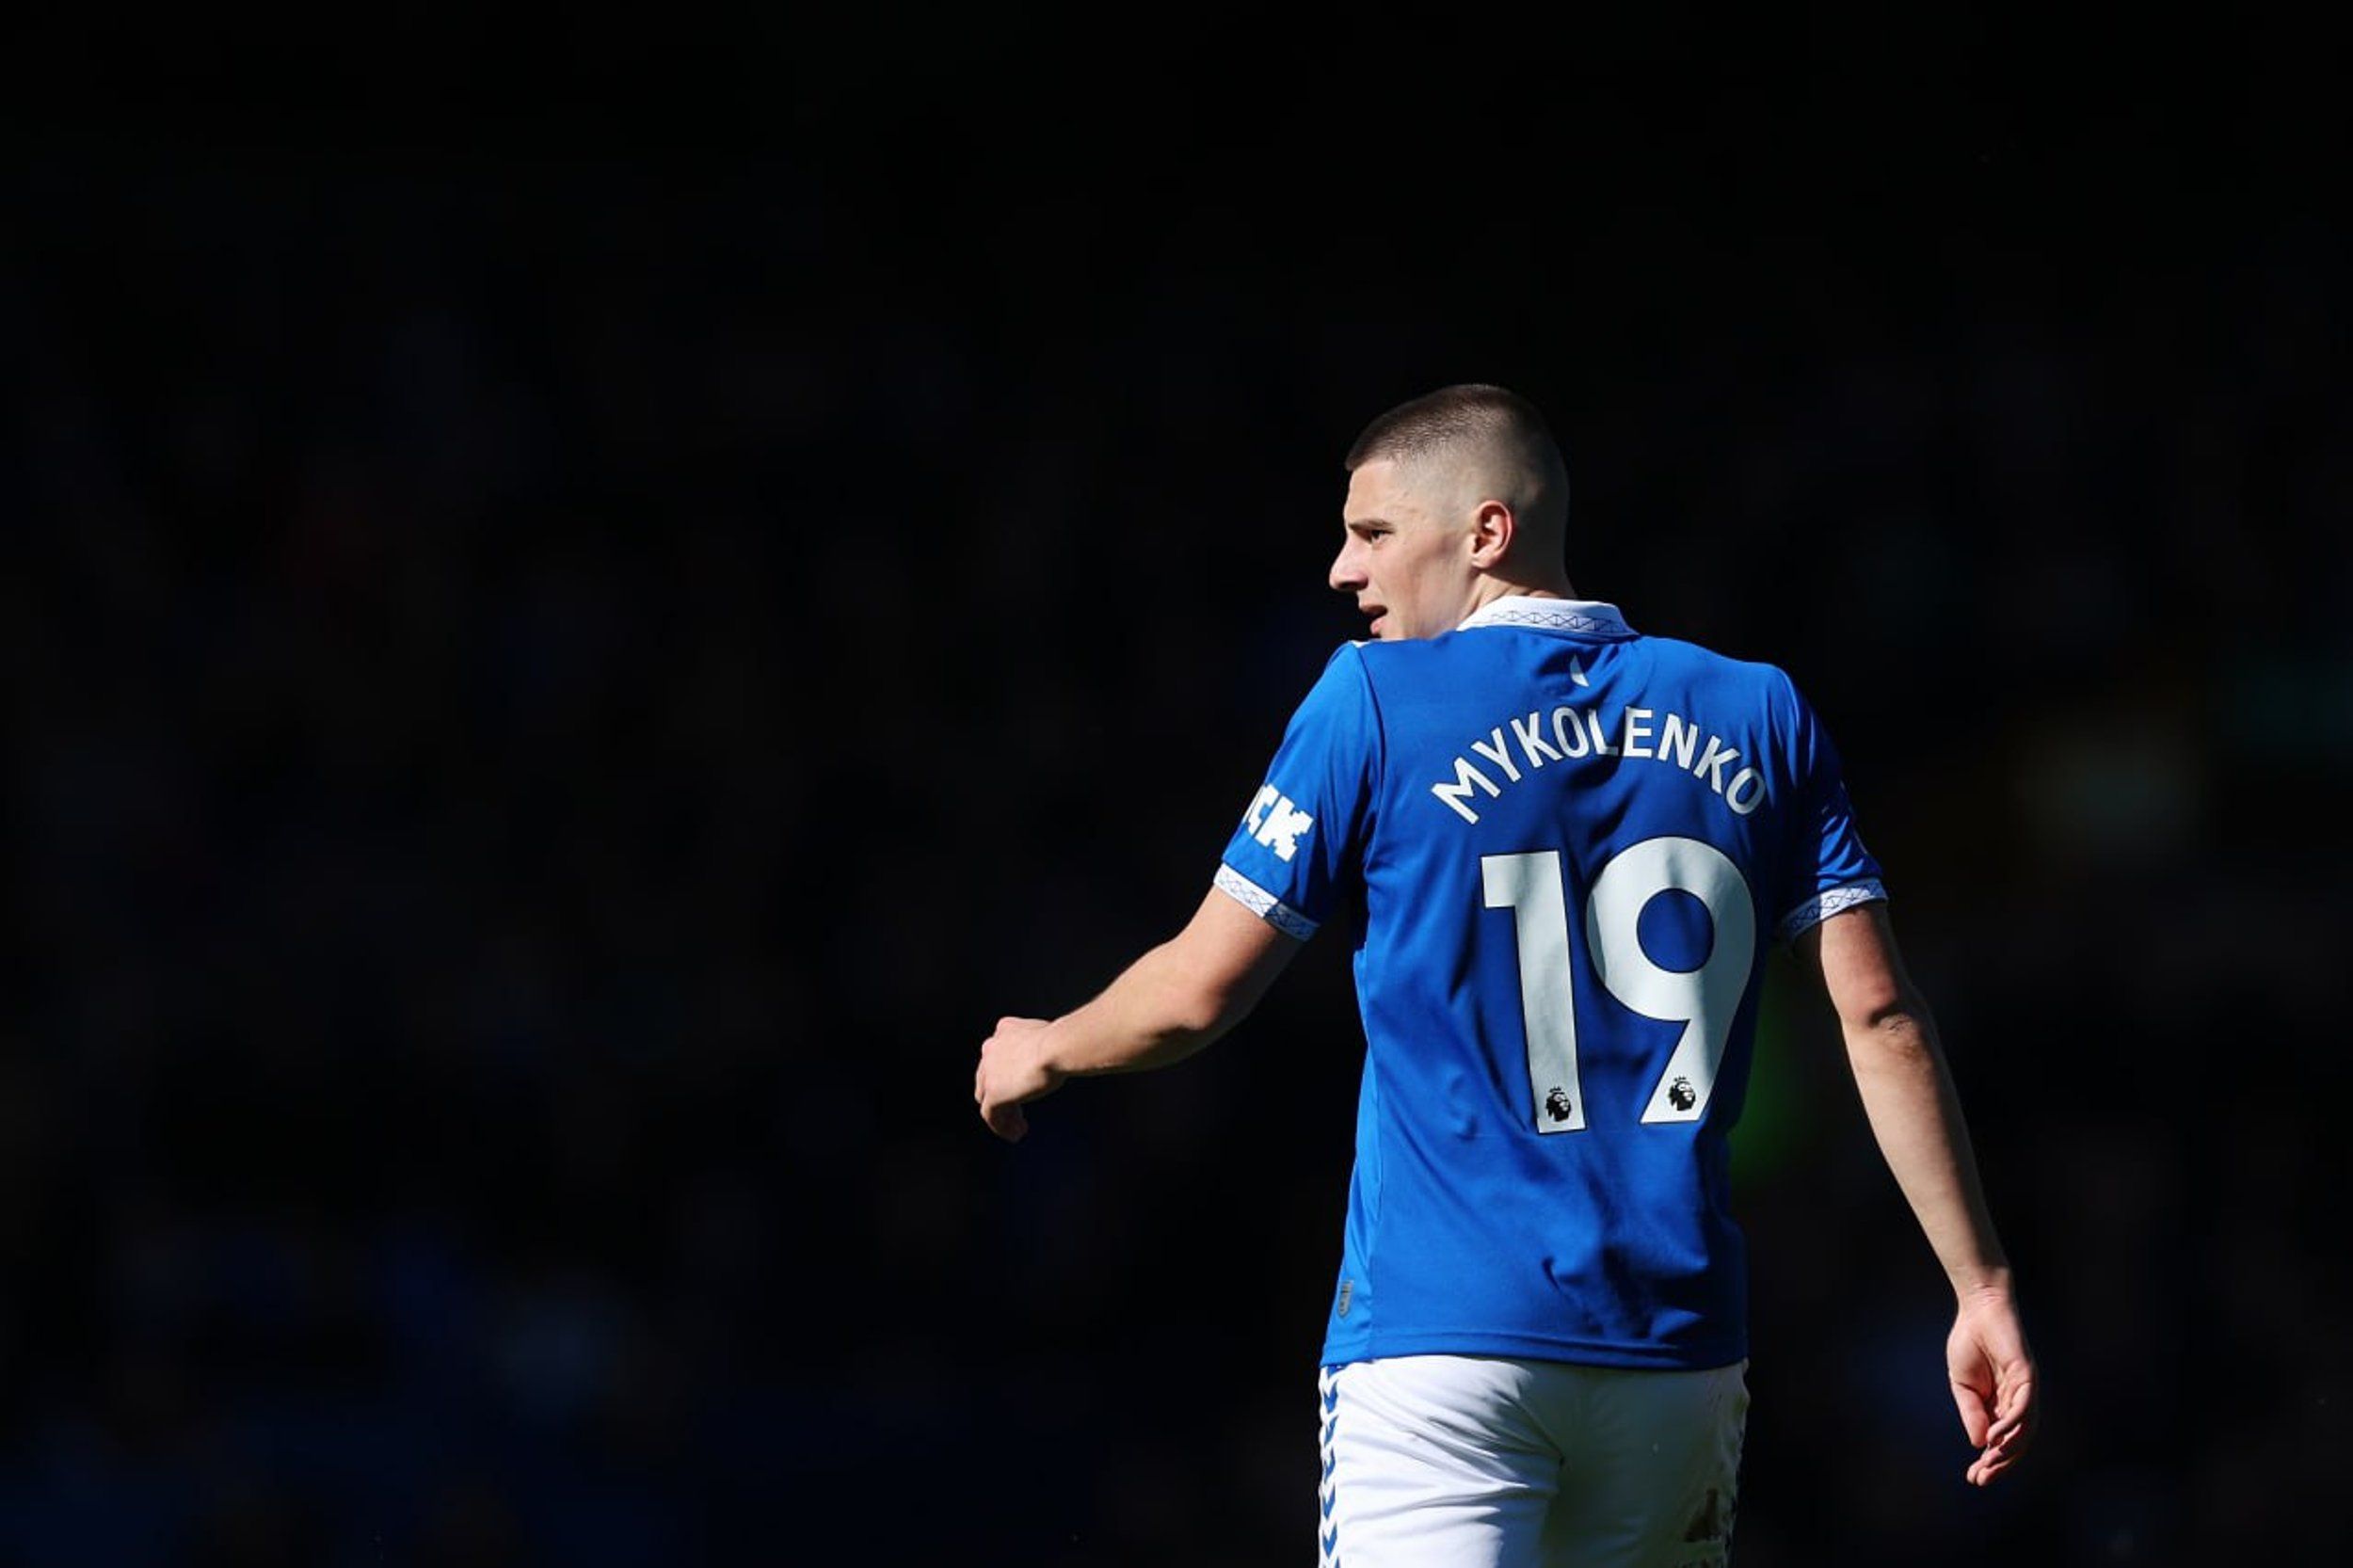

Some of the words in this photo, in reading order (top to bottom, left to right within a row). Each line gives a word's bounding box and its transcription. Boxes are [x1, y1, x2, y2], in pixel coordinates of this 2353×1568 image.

[1242, 783, 1315, 863] CK
[1431, 706, 1768, 824] MYKOLENKO
[1481, 836, 1757, 1135] 19
